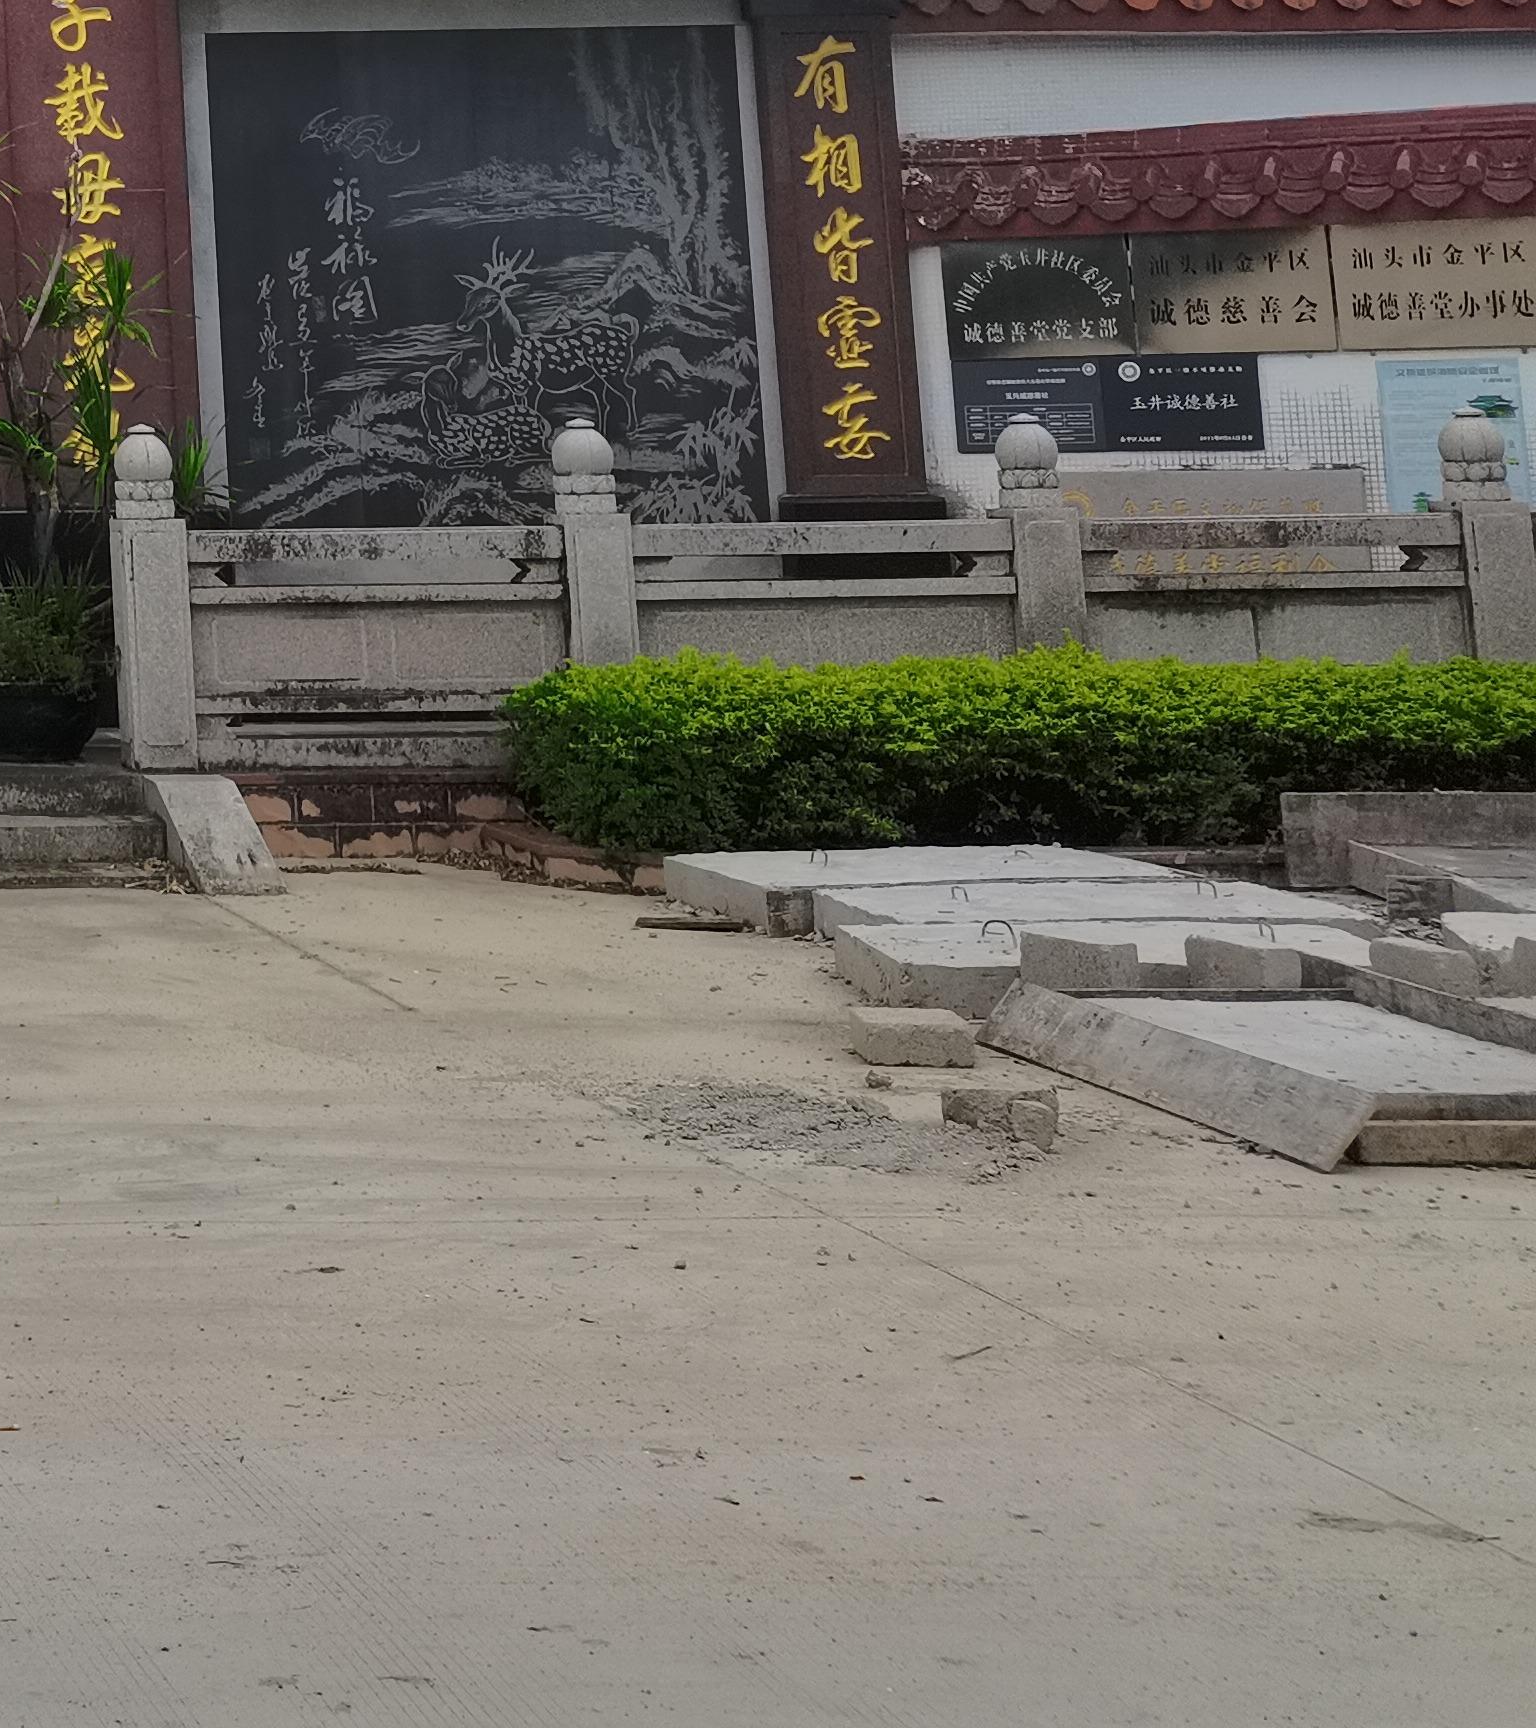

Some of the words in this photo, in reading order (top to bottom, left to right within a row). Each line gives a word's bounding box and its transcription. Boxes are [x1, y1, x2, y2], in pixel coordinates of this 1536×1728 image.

[1147, 246, 1310, 278] 汕头市金平区
[1351, 239, 1527, 272] 汕头市金平区
[953, 246, 1123, 315] 中国共产党玉井社区委员会
[1148, 294, 1319, 327] 诚德慈善会
[1351, 286, 1536, 324] 诚德善堂办事处
[962, 316, 1120, 345] 诚德善堂党支部
[1129, 391, 1240, 413] 玉井诚德善社
